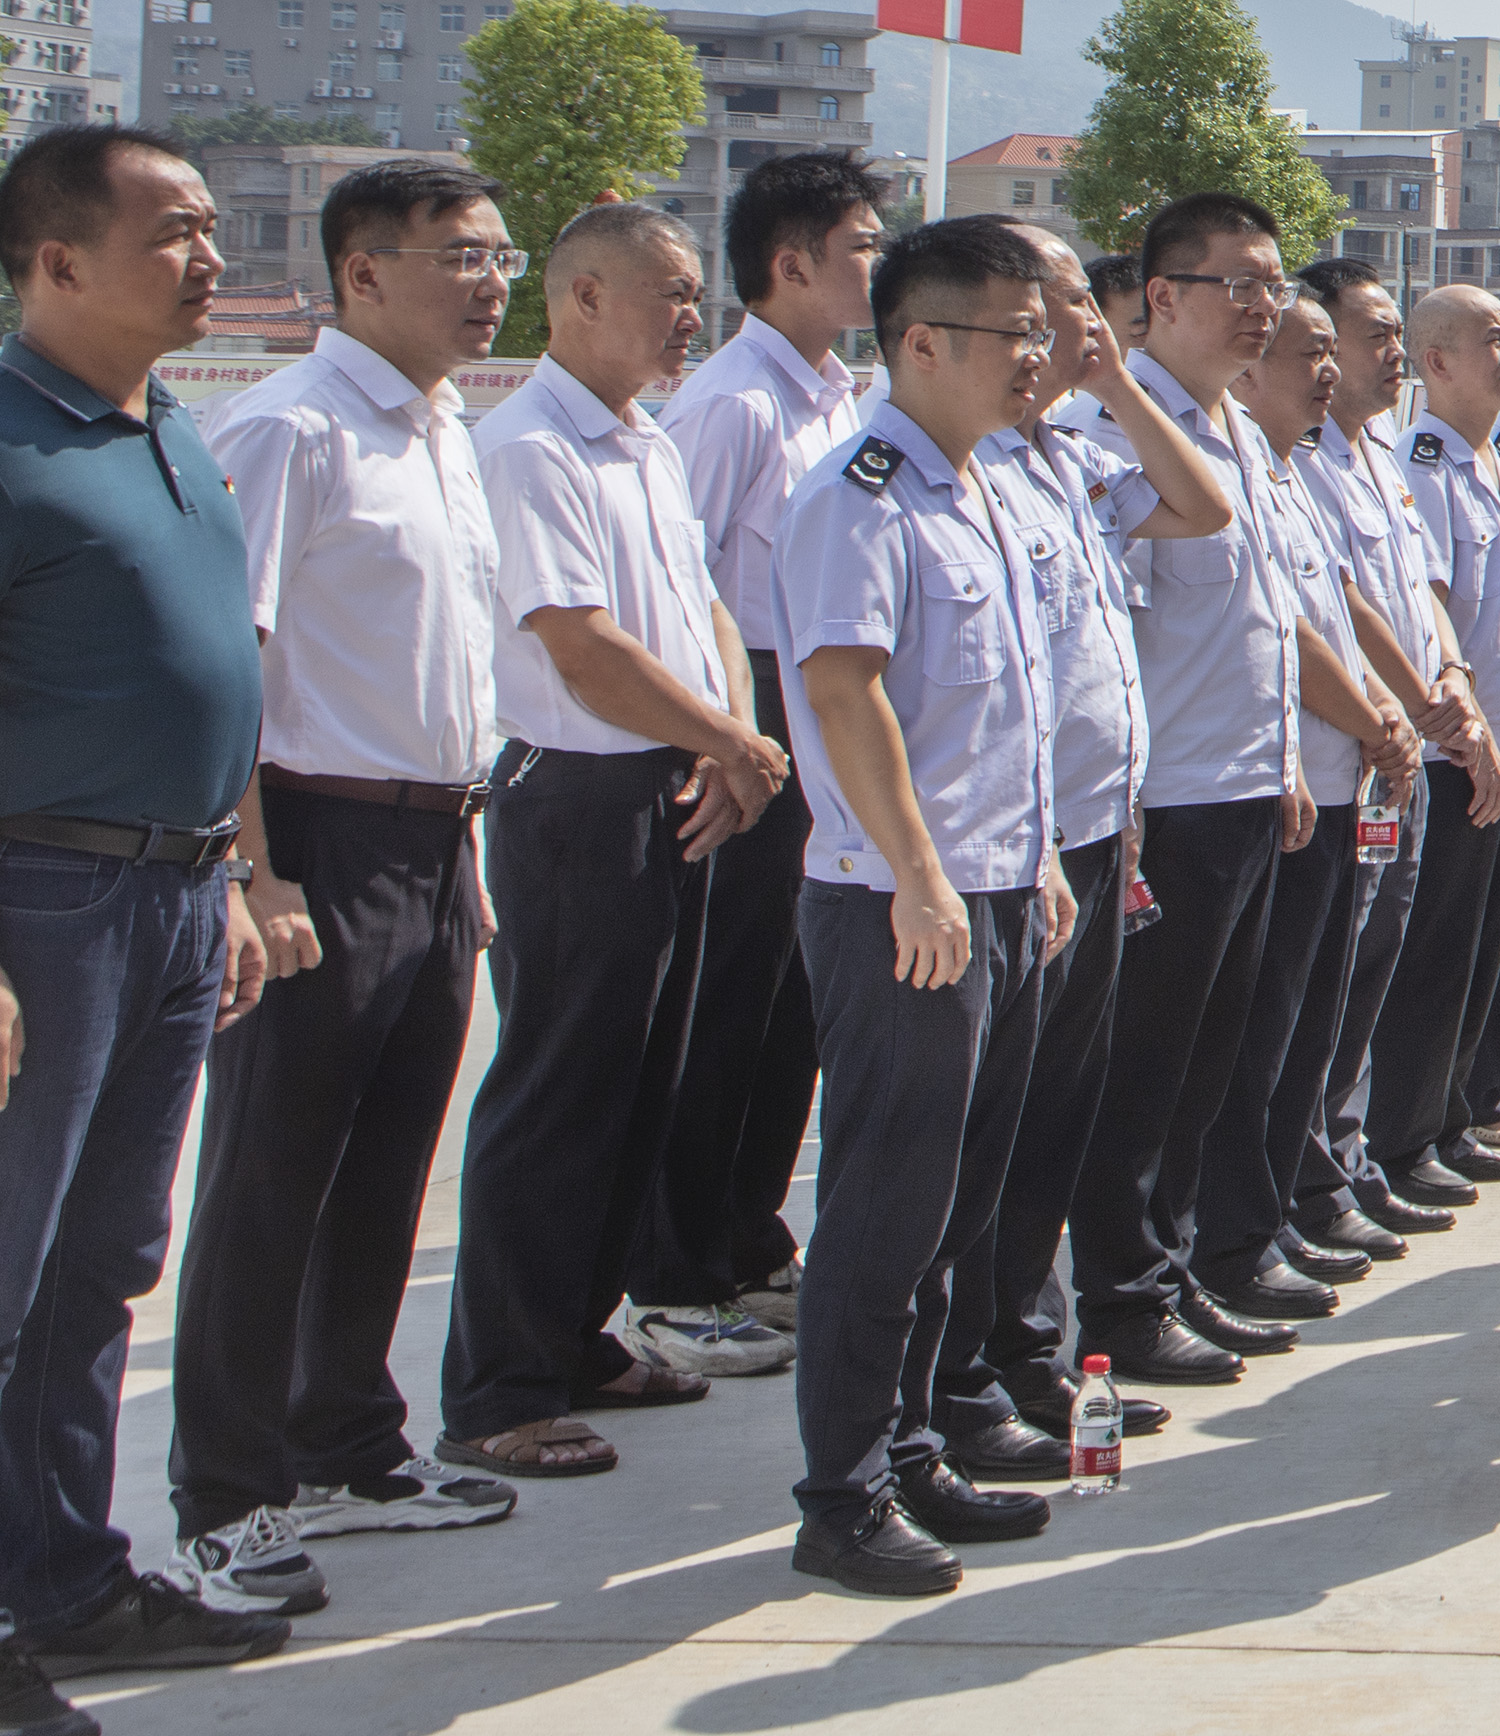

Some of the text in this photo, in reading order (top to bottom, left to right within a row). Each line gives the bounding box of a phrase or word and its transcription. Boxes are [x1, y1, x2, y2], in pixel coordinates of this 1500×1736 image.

[153, 366, 277, 383] 新镇省身村戏台
